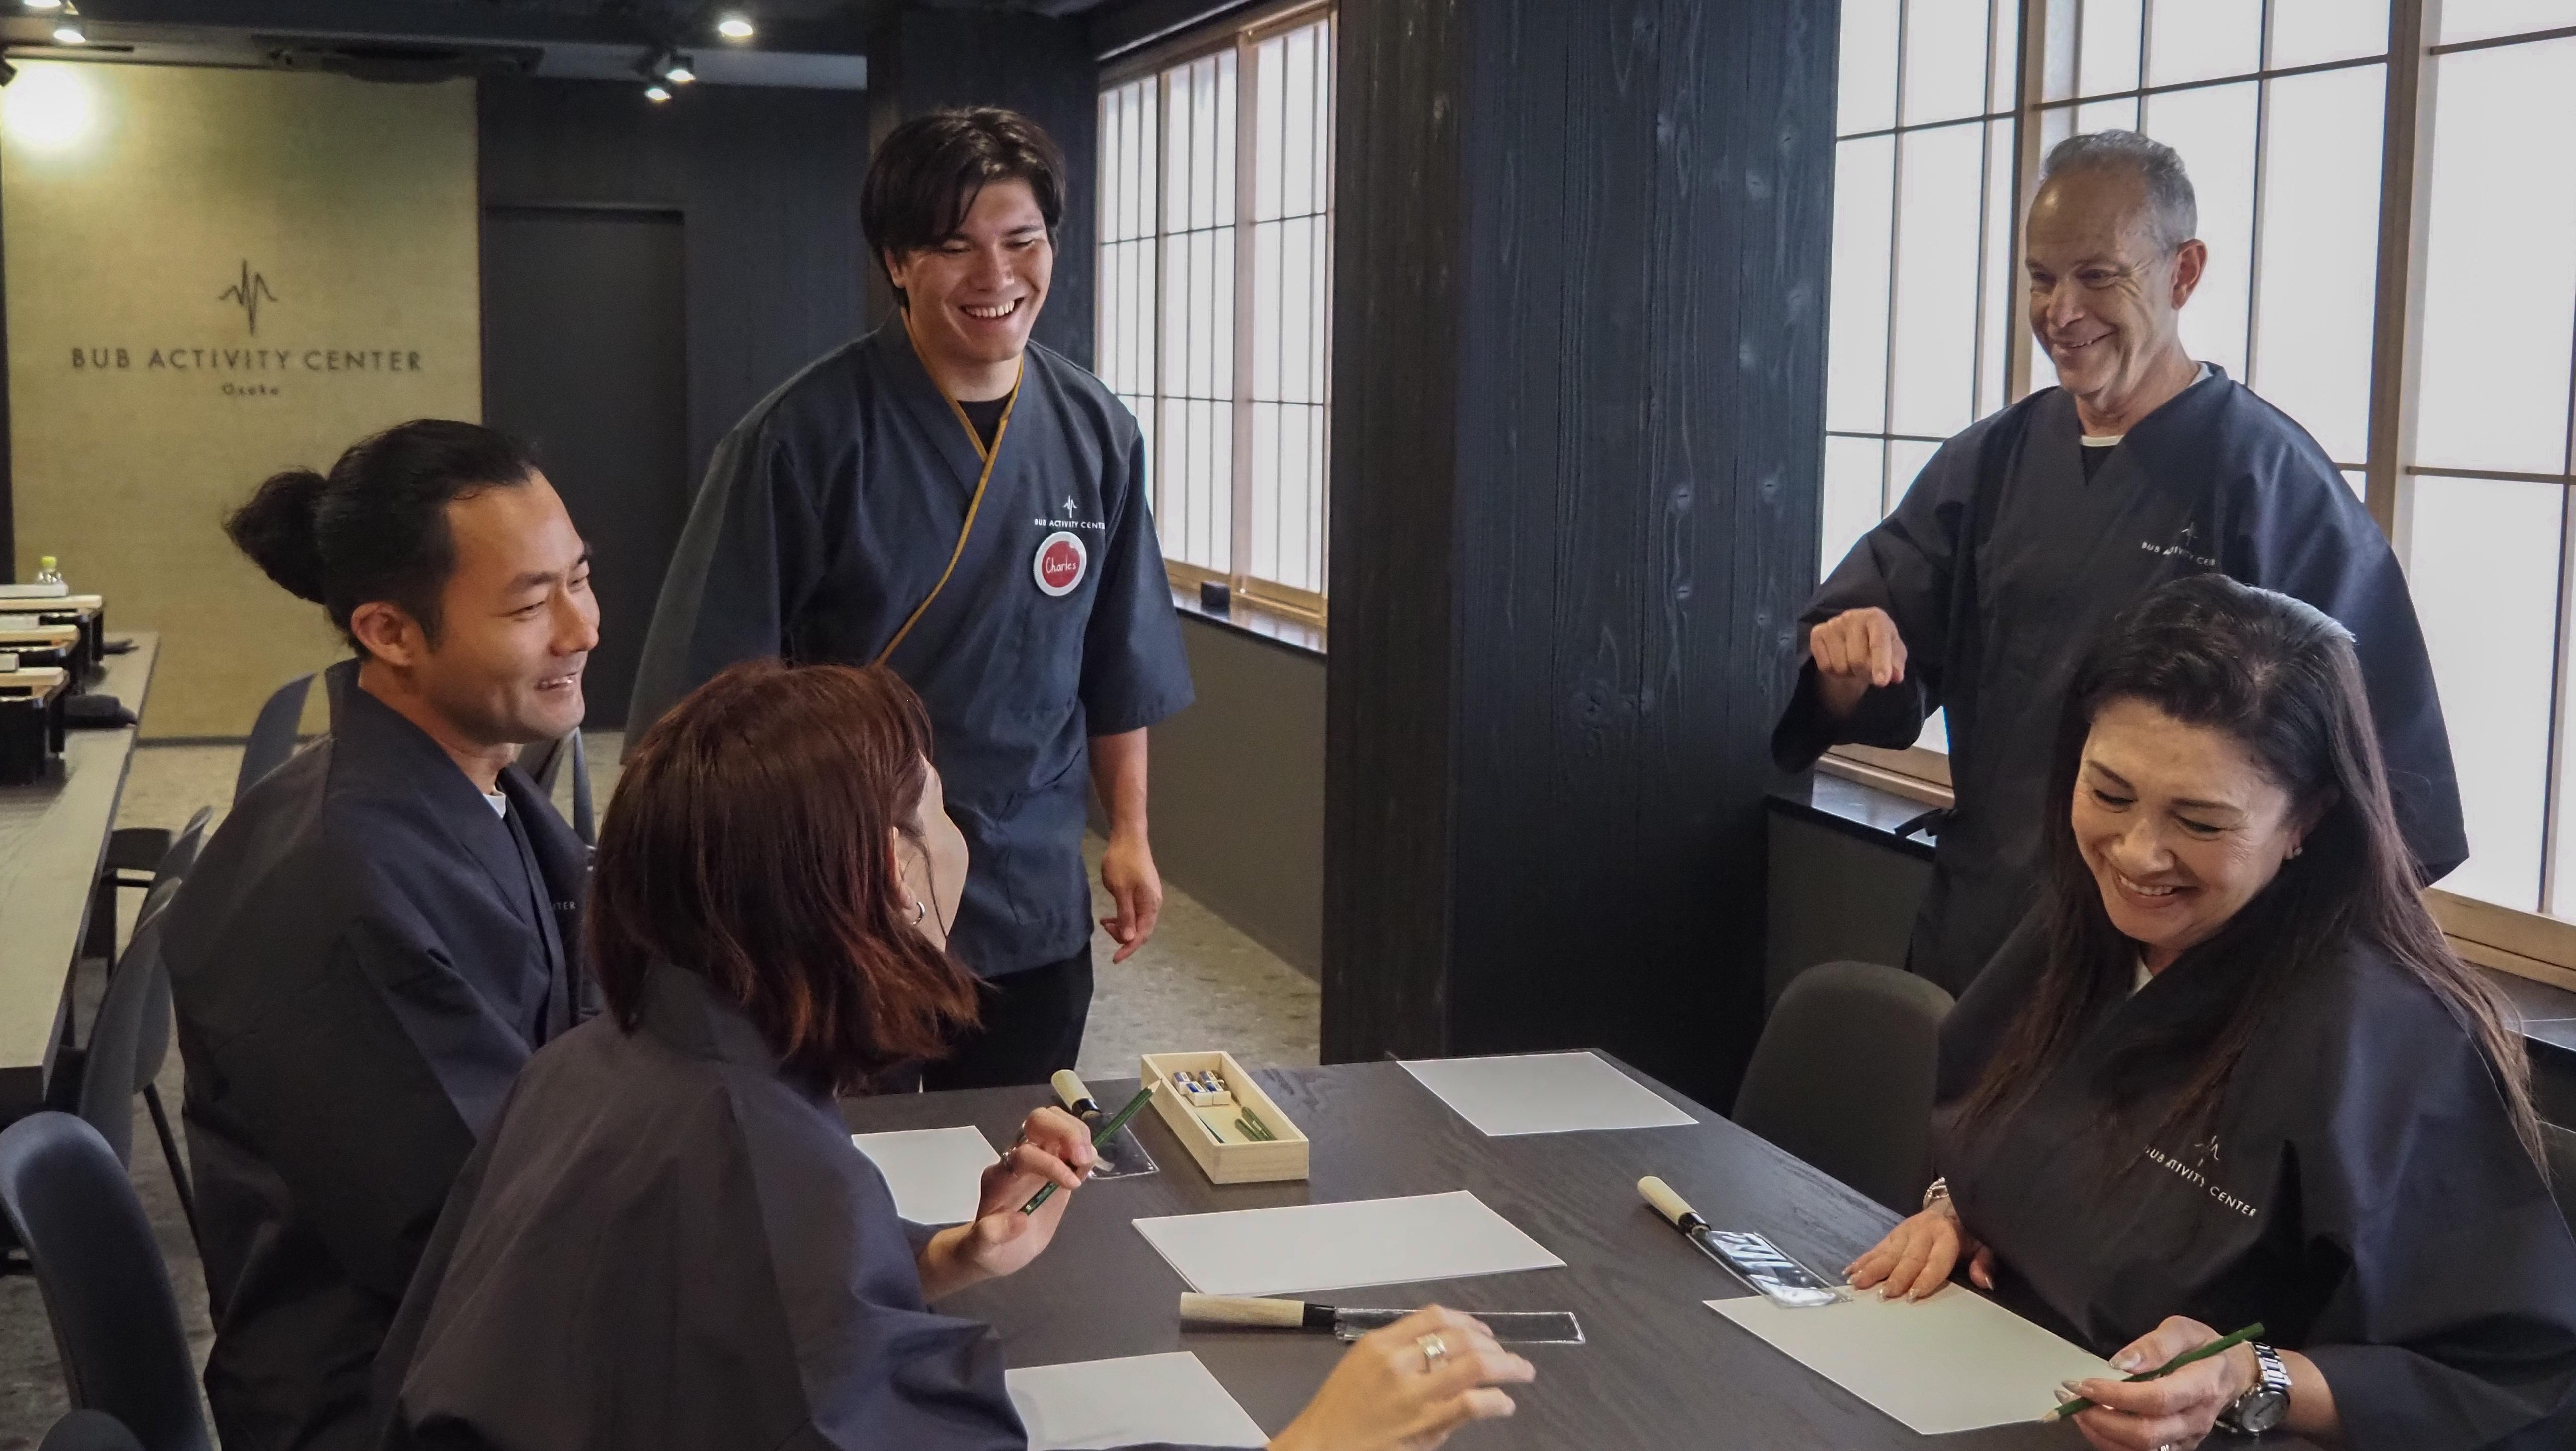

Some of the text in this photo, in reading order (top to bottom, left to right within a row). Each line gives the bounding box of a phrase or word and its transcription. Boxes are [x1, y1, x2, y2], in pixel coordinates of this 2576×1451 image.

[72, 348, 421, 371] BUB ACTIVITY CENTER
[1049, 520, 1078, 528] ACTIVITY
[2142, 542, 2160, 552] BUB
[1046, 554, 1076, 573] Charles
[2210, 1186, 2256, 1217] CENTER
